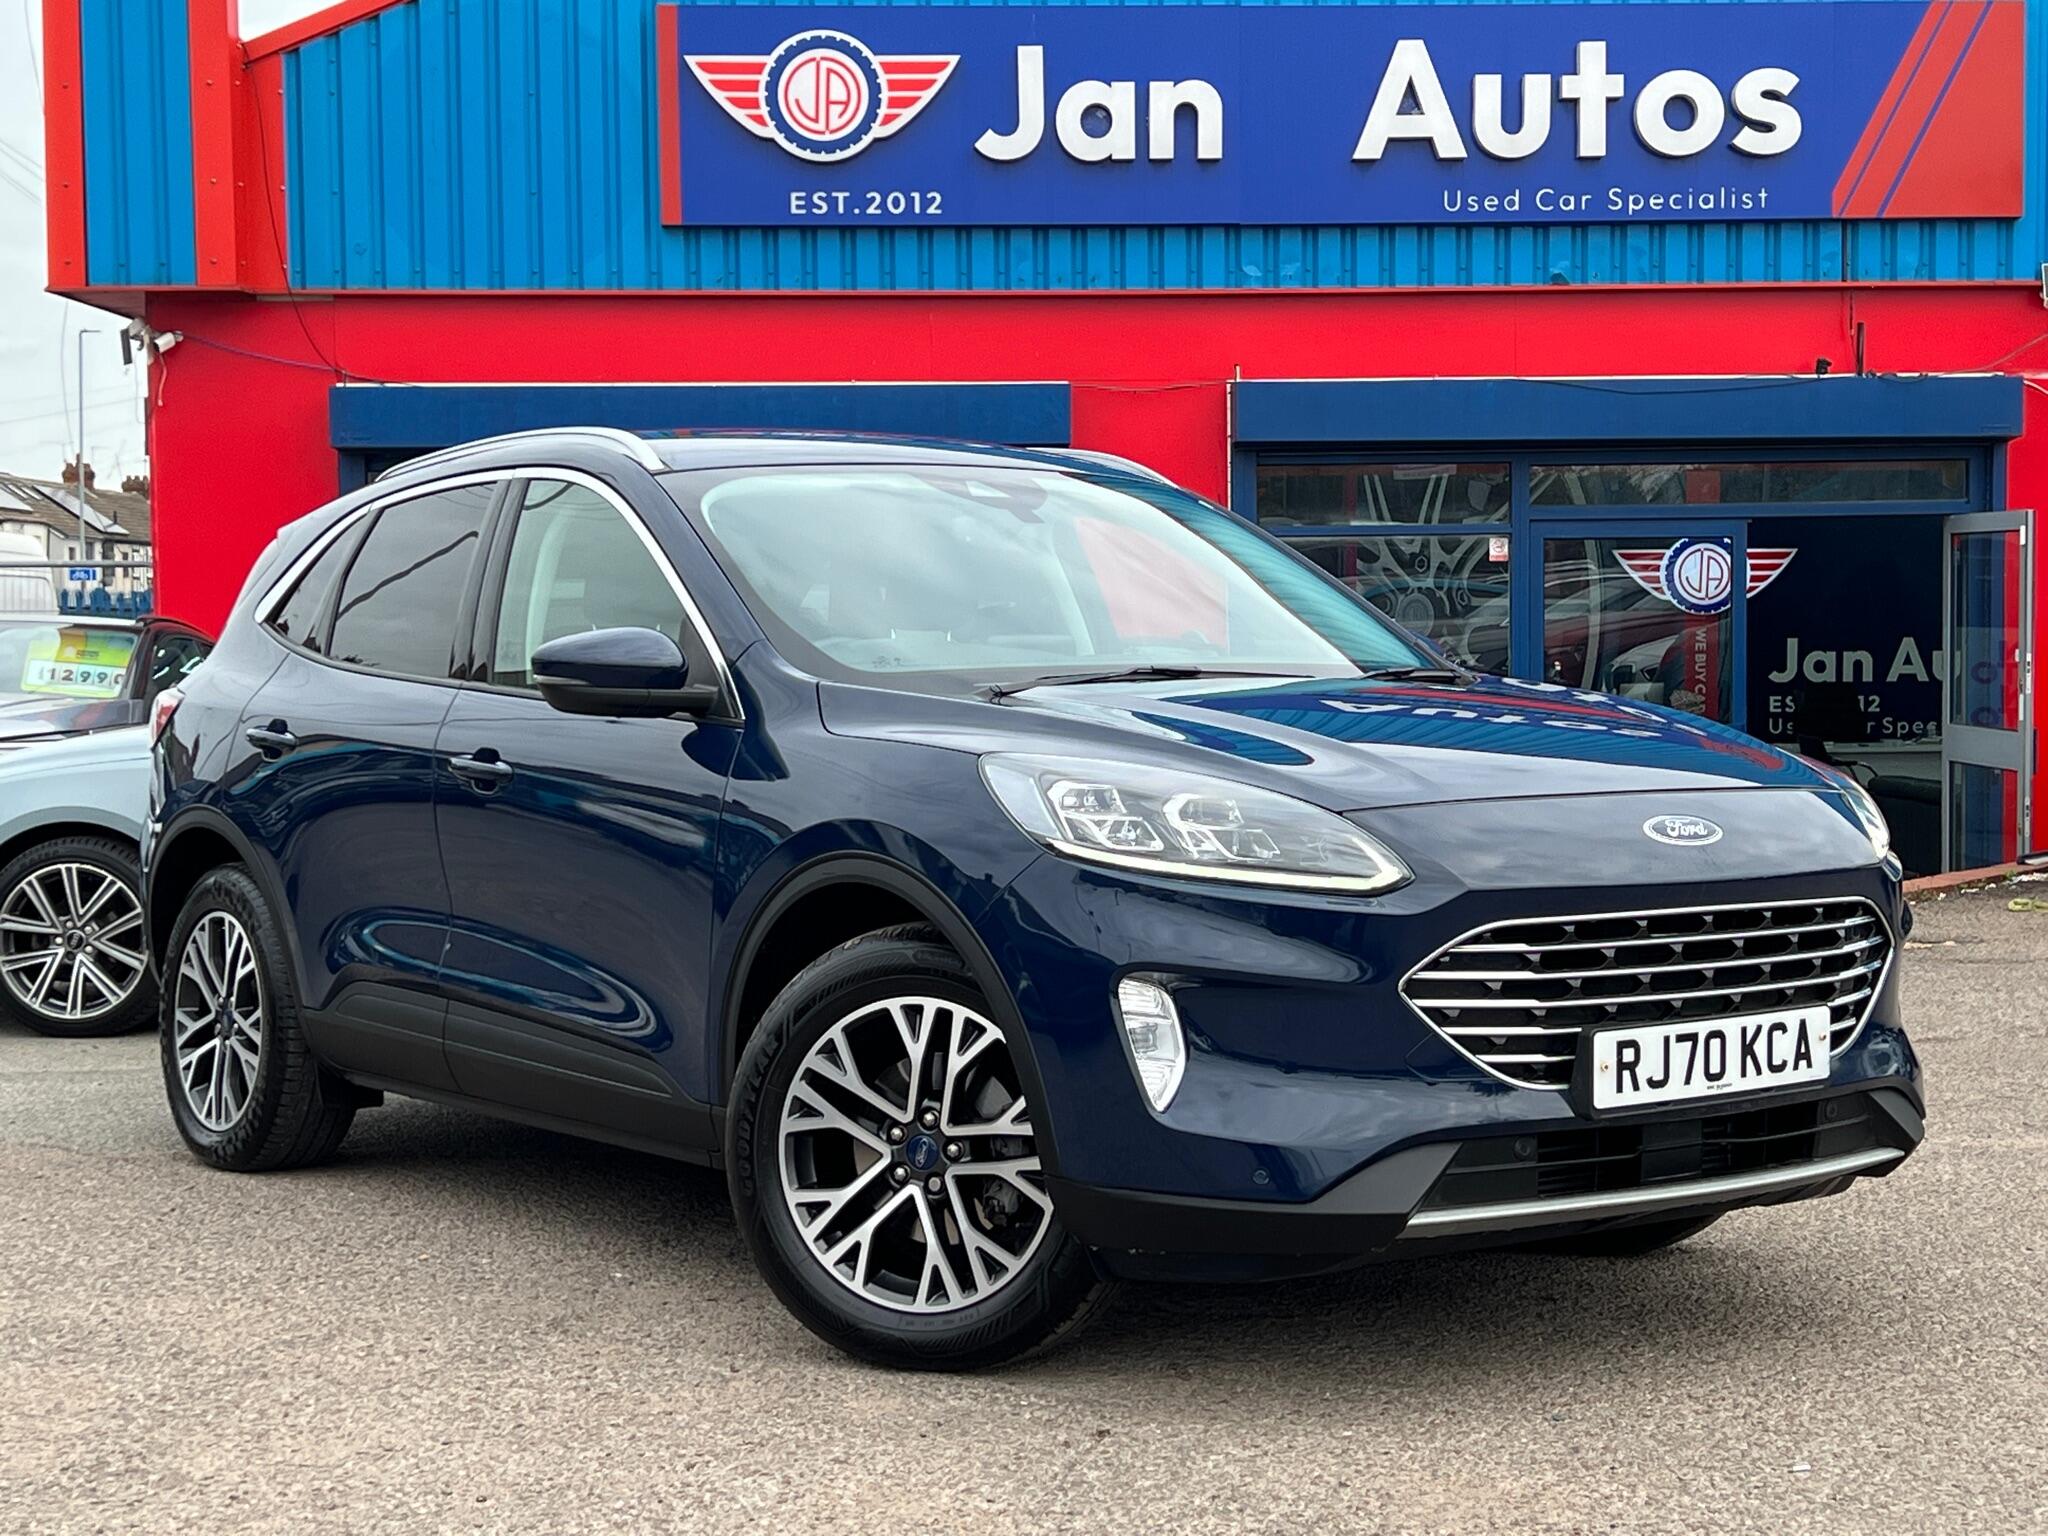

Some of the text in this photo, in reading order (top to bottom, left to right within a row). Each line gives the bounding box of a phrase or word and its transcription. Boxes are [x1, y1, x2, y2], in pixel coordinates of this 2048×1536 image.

[974, 39, 1802, 161] Jan Autos
[790, 191, 942, 215] EST.2012
[1443, 186, 1769, 216] Used Car Specialist
[1694, 627, 1707, 651] WE
[1694, 653, 1707, 682] BUY
[1767, 637, 1873, 683] Jan
[1615, 1017, 1814, 1095] RJ70 KCA
